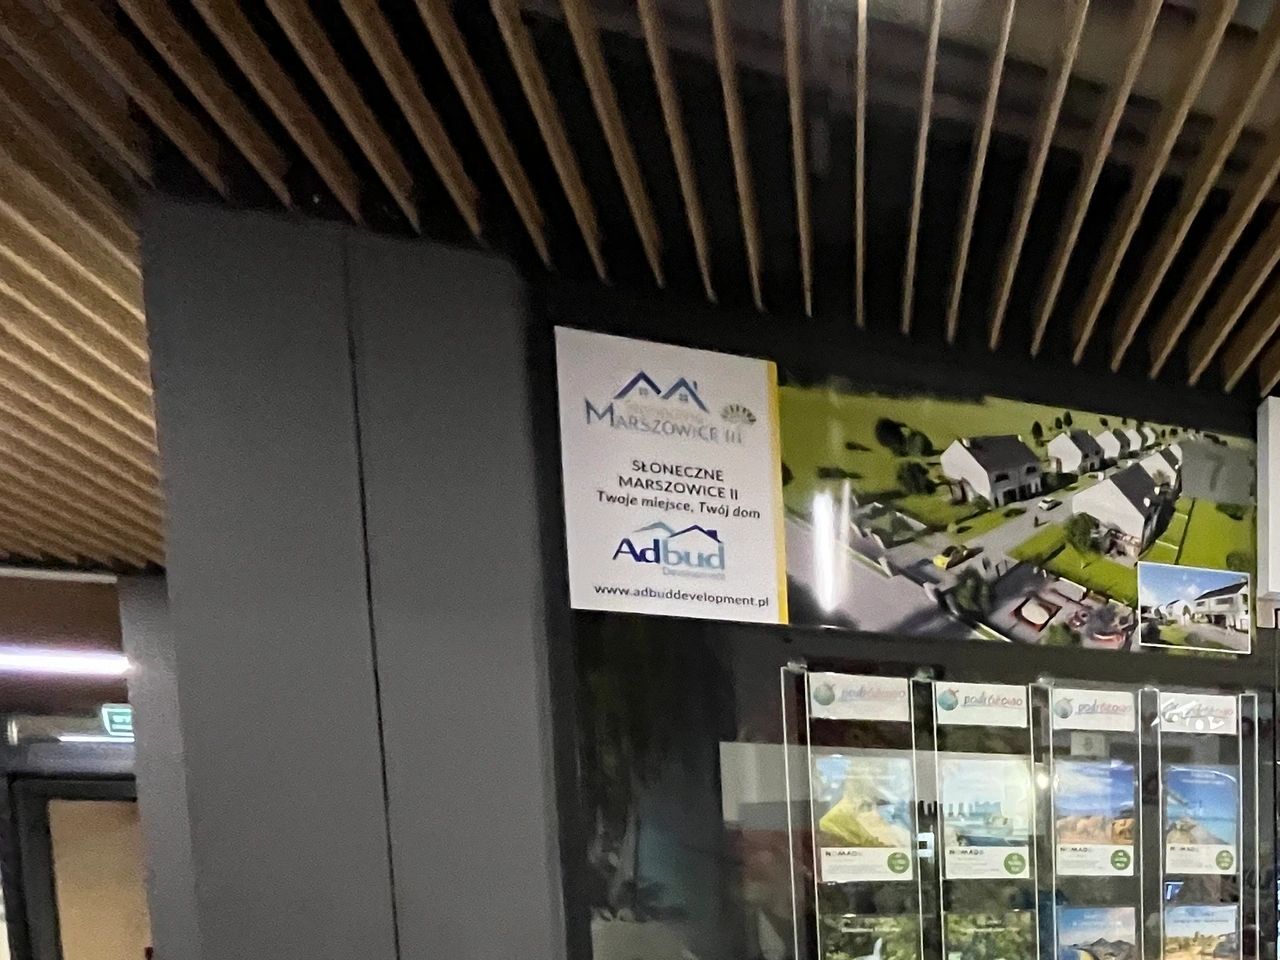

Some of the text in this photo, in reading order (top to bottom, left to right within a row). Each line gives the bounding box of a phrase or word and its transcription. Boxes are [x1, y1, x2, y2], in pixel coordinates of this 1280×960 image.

[584, 398, 718, 443] MARSZOWICE
[632, 460, 724, 482] SŁONECZNE
[618, 475, 739, 501] MARSZOWICE II
[597, 490, 760, 519] Twoje miejsce, Twój dom
[612, 537, 726, 570] Adbud
[594, 585, 769, 607] www.adbuddevelopment.pl
